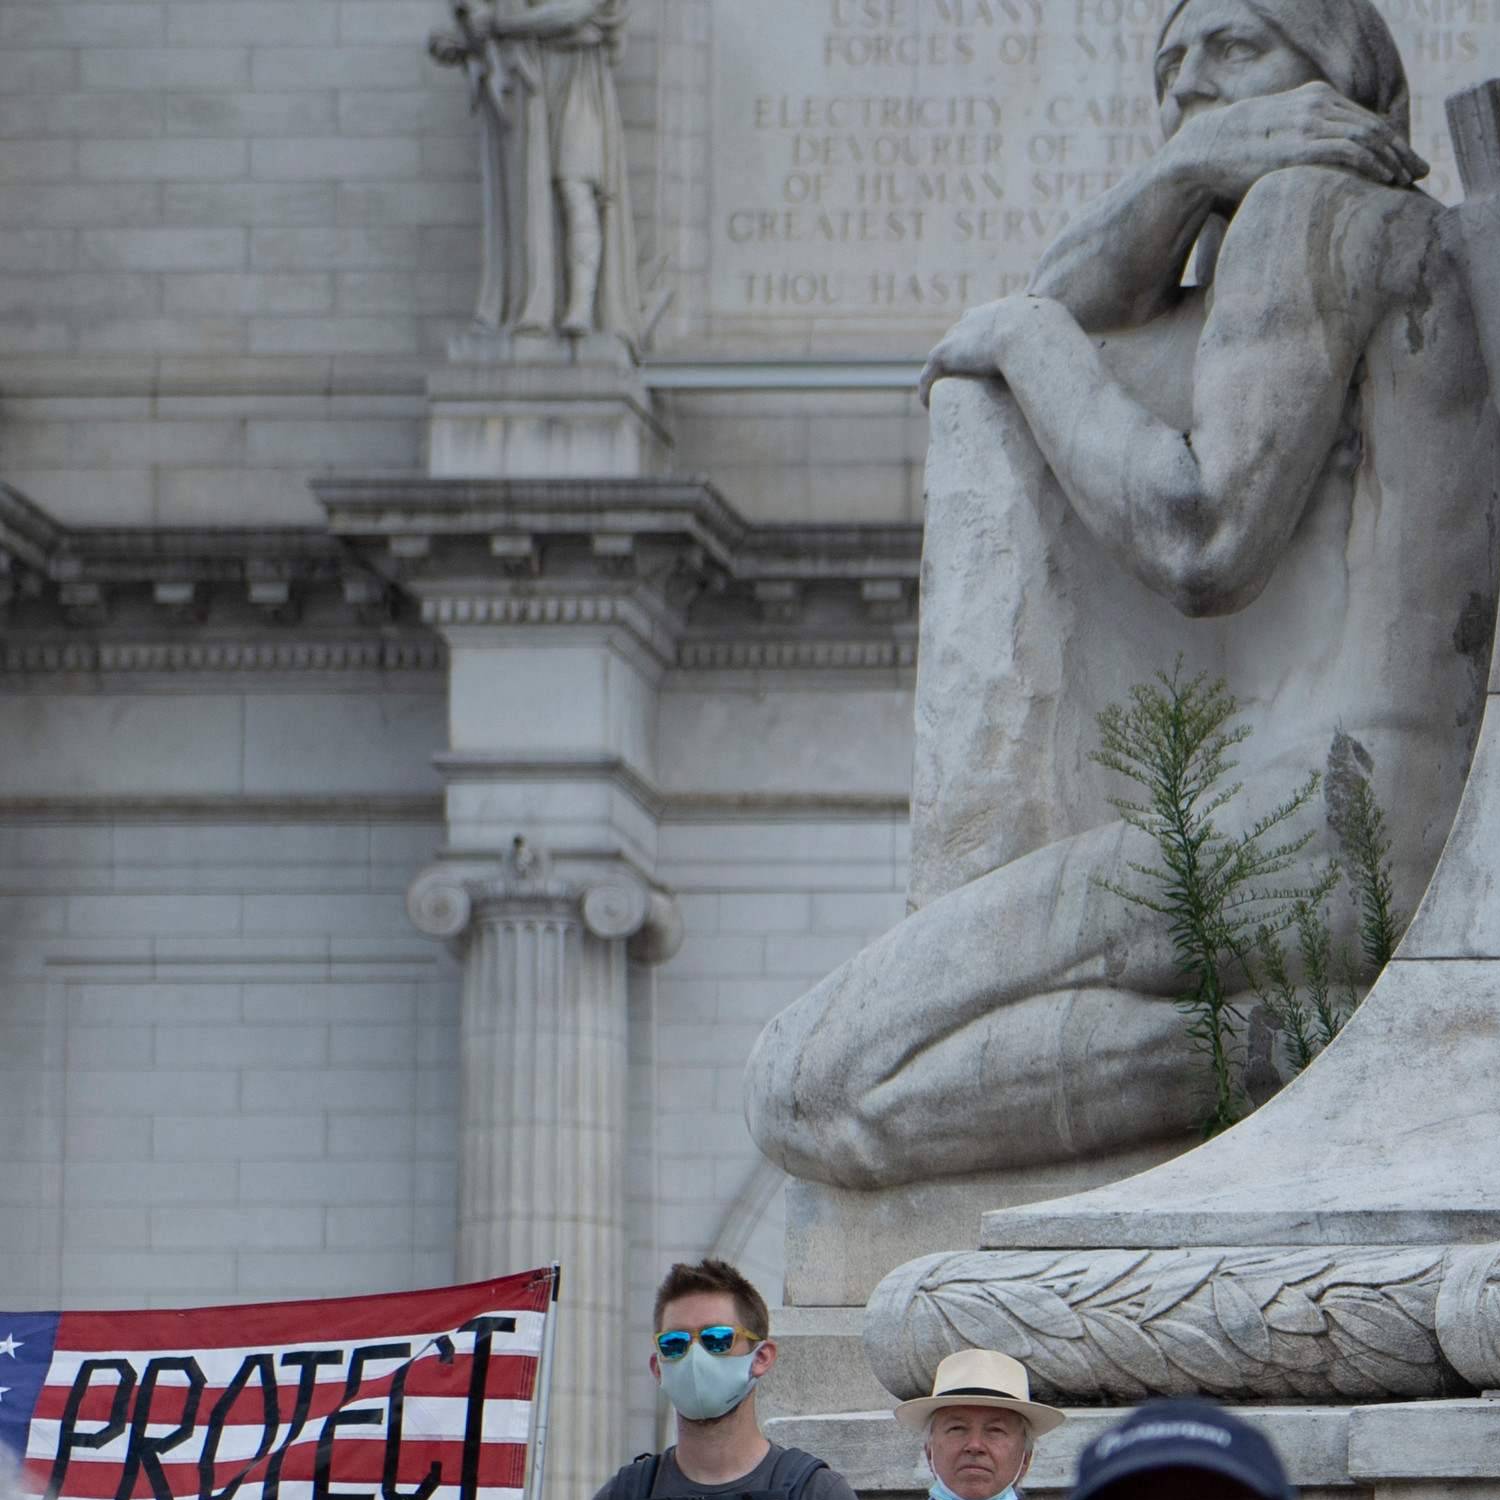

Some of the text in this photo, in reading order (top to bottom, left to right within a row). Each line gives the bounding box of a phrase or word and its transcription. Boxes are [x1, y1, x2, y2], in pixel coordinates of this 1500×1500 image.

[1072, 0, 1164, 26] FOO
[822, 32, 1146, 66] FORCES OF NAT
[753, 97, 1152, 129] ELECTRICITY CARR
[792, 135, 1004, 165] DEVOURER
[1027, 135, 1074, 164] OF
[783, 172, 828, 203] OF
[856, 172, 1004, 203] HUMAN
[726, 210, 927, 243] GREATEST
[735, 272, 838, 304] THOU
[868, 272, 976, 303] HAST
